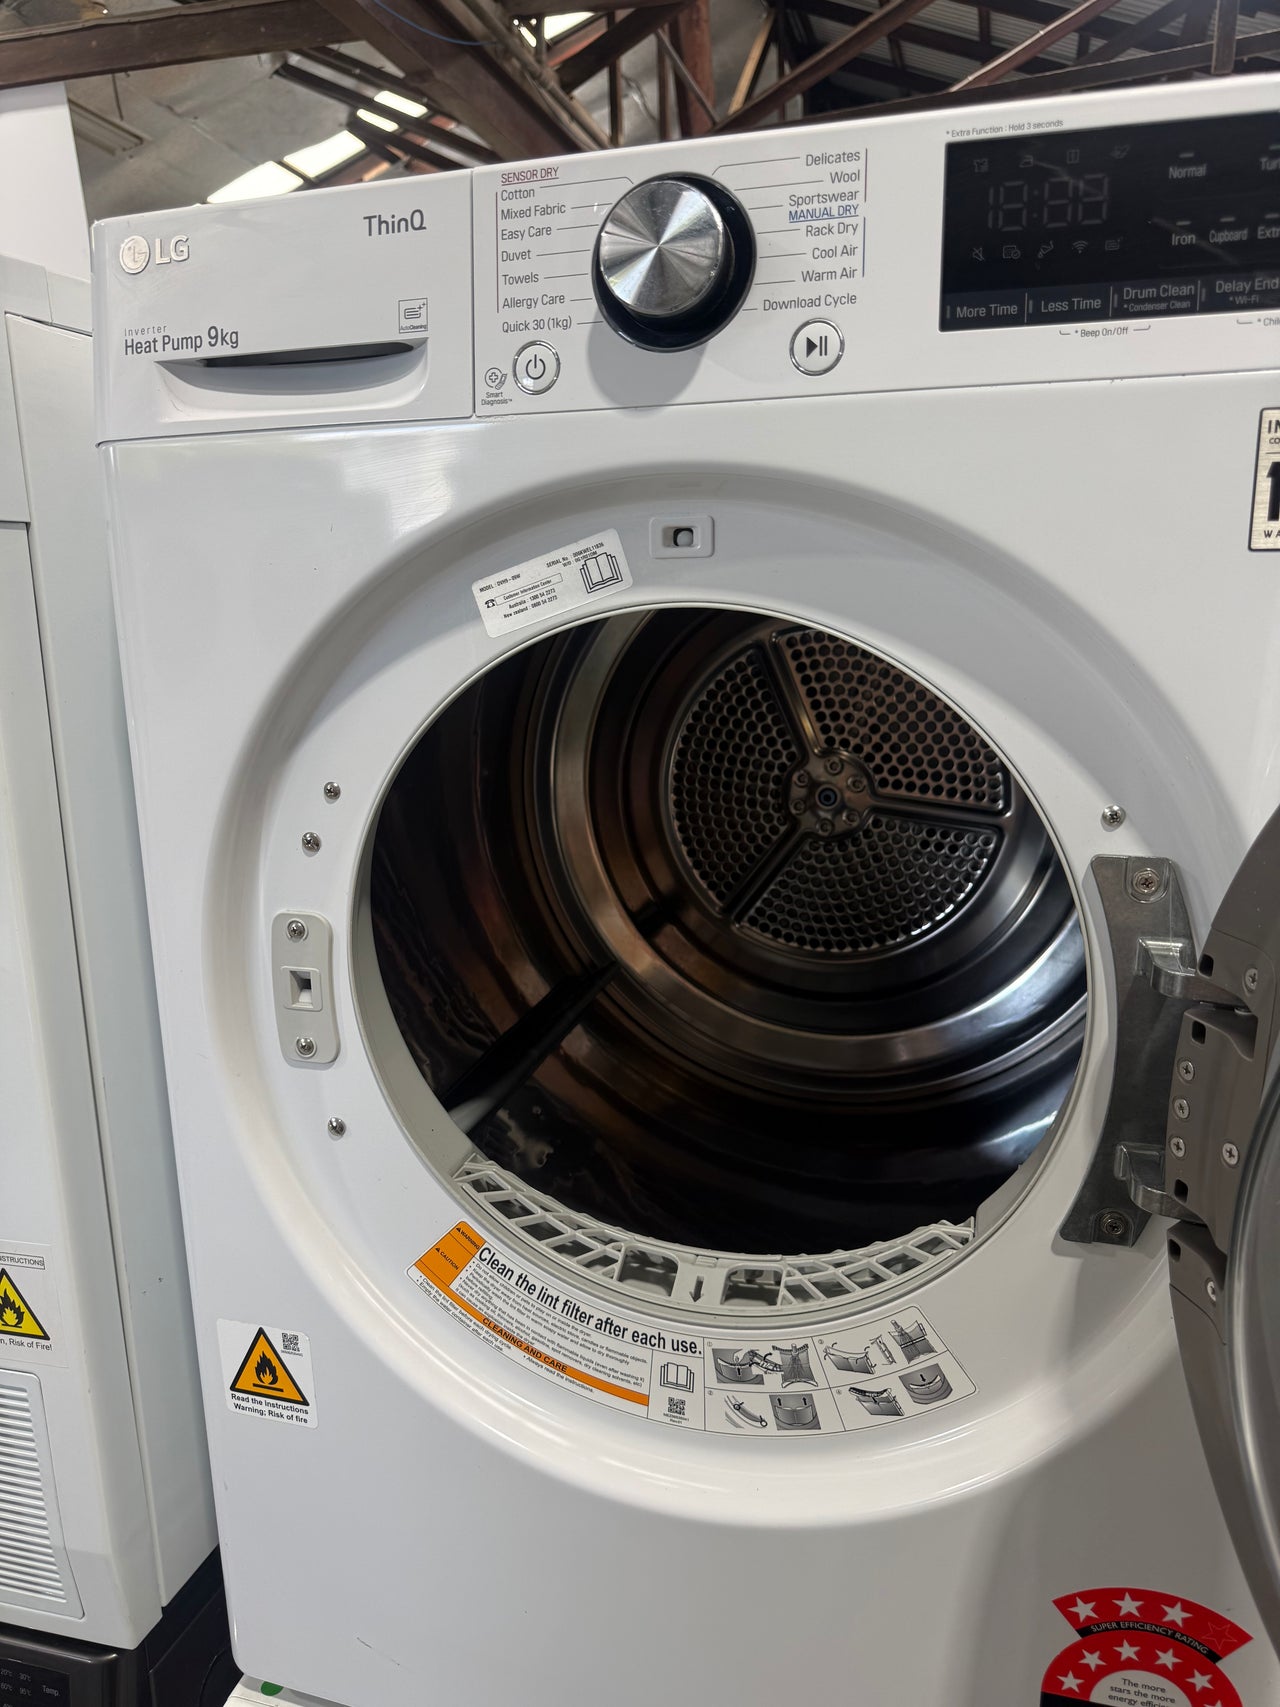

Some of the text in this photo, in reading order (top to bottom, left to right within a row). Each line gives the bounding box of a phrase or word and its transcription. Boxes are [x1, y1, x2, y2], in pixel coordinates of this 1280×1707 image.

[952, 128, 971, 138] Extra
[972, 125, 1003, 136] Function
[1008, 122, 1025, 133] Hold
[1027, 122, 1032, 130] 3
[1033, 119, 1064, 129] seconds
[806, 151, 860, 167] Delicates
[501, 167, 559, 184] SENSOR DRY
[830, 170, 860, 184] Wool
[1169, 164, 1207, 179] Normal
[501, 188, 535, 202] Cotton
[789, 190, 859, 209] Sportswear
[501, 203, 566, 221] Mixed Fabric
[789, 204, 859, 222] MANUAL DRY
[363, 209, 427, 236] ThinQ
[806, 222, 858, 238] Rack Dry
[501, 226, 552, 241] Easy Care
[1171, 233, 1196, 246] Iron
[1209, 229, 1249, 244] Cupboard
[155, 235, 190, 266] LG
[501, 249, 531, 262] Duvet
[812, 244, 858, 260] Cool Air
[502, 272, 539, 285] Towels
[801, 267, 857, 283] Warm Air
[1124, 284, 1195, 300] Drum Clean
[1216, 278, 1280, 294] Delay End
[503, 294, 565, 309] Allergy Care
[764, 293, 857, 311] Download Cycle
[1041, 298, 1102, 313] Less Time
[1129, 300, 1191, 313] Condenser Clean
[956, 303, 1018, 319] More Time
[125, 325, 167, 337] Inverter
[502, 316, 572, 334] Quick 30 (1kg)
[1080, 326, 1129, 339] Beep On/Off
[125, 326, 239, 356] Heat Pump 9kg
[479, 583, 494, 592] MODEL
[503, 578, 552, 600] Customer Information Center
[508, 599, 526, 609] Australia
[460, 1230, 480, 1250] WARNING
[440, 1252, 459, 1271] CAUTION
[479, 1247, 702, 1355] Clean the lint filter after each use.
[9, 1338, 25, 1347] Risk
[482, 1317, 568, 1372] CLEANING AND CARE
[231, 1394, 250, 1403] Read
[268, 1410, 285, 1419] Risk
[1091, 1621, 1209, 1654] SUPER EFFICIENCY RATING
[1122, 1678, 1166, 1693] The more
[1108, 1694, 1138, 1706] energy
[1110, 1686, 1176, 1703] stars the more
